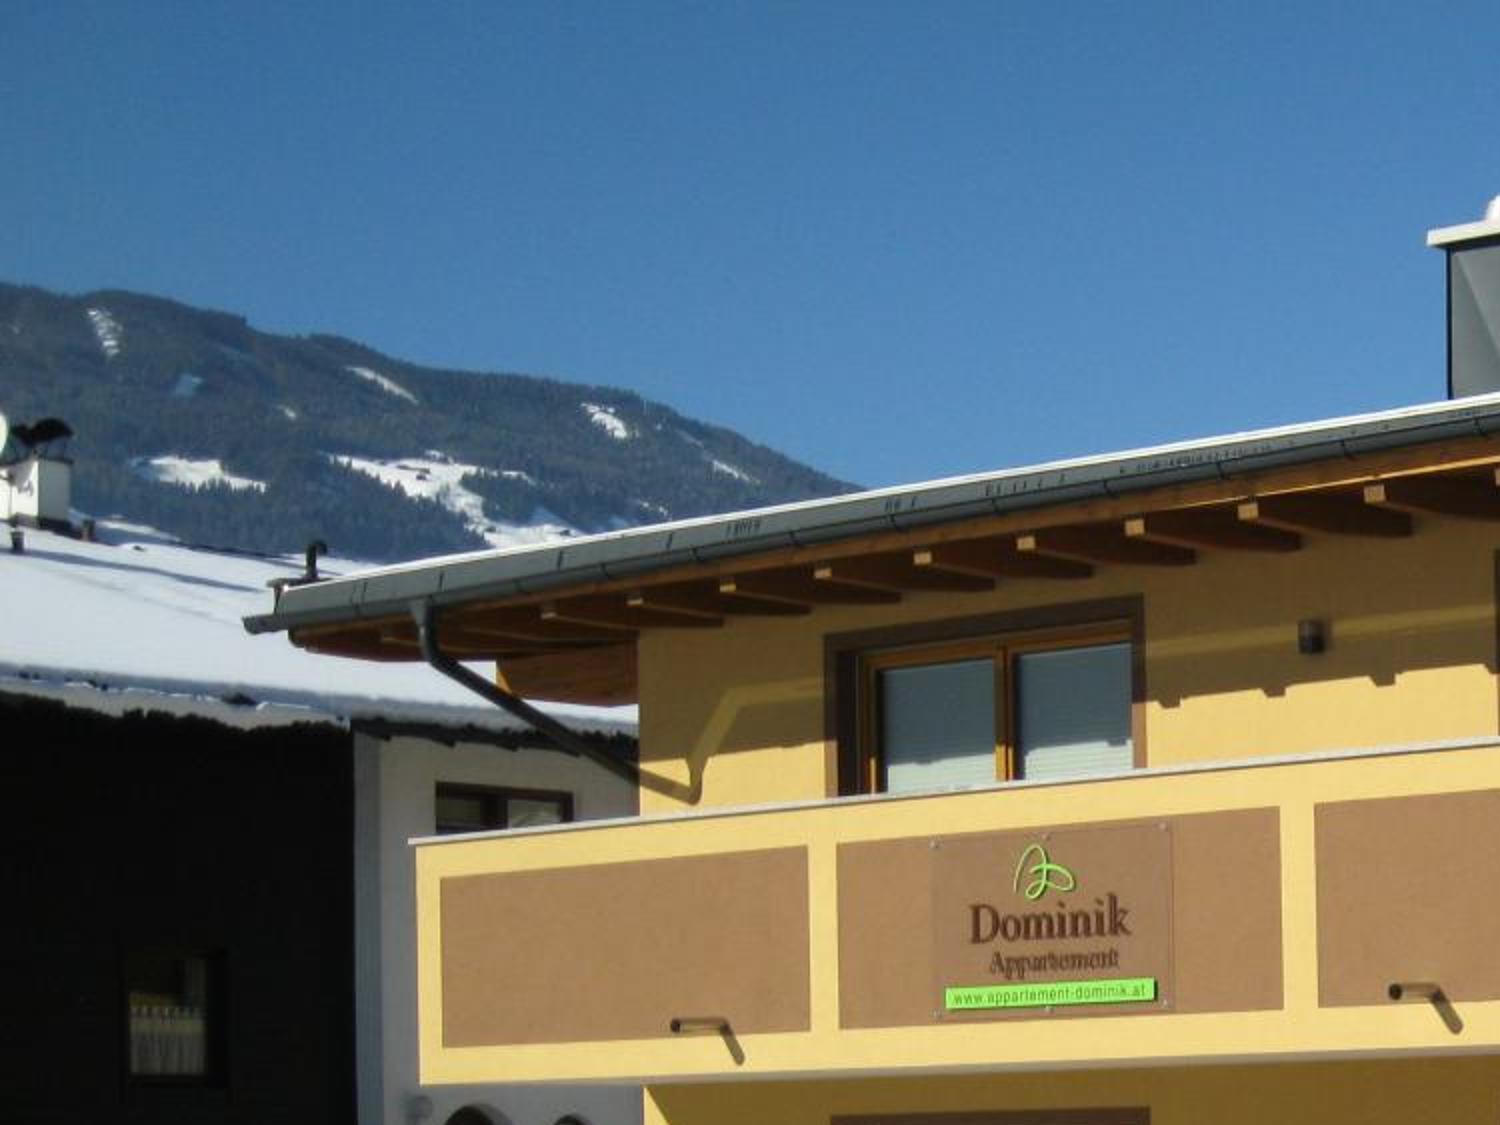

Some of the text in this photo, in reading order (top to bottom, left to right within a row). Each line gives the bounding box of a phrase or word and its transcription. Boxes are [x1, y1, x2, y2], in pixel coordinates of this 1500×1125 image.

[969, 893, 1132, 944] Dominik
[990, 948, 1119, 980] Appartement
[953, 984, 1146, 1006] www.appartement-dominik.at
